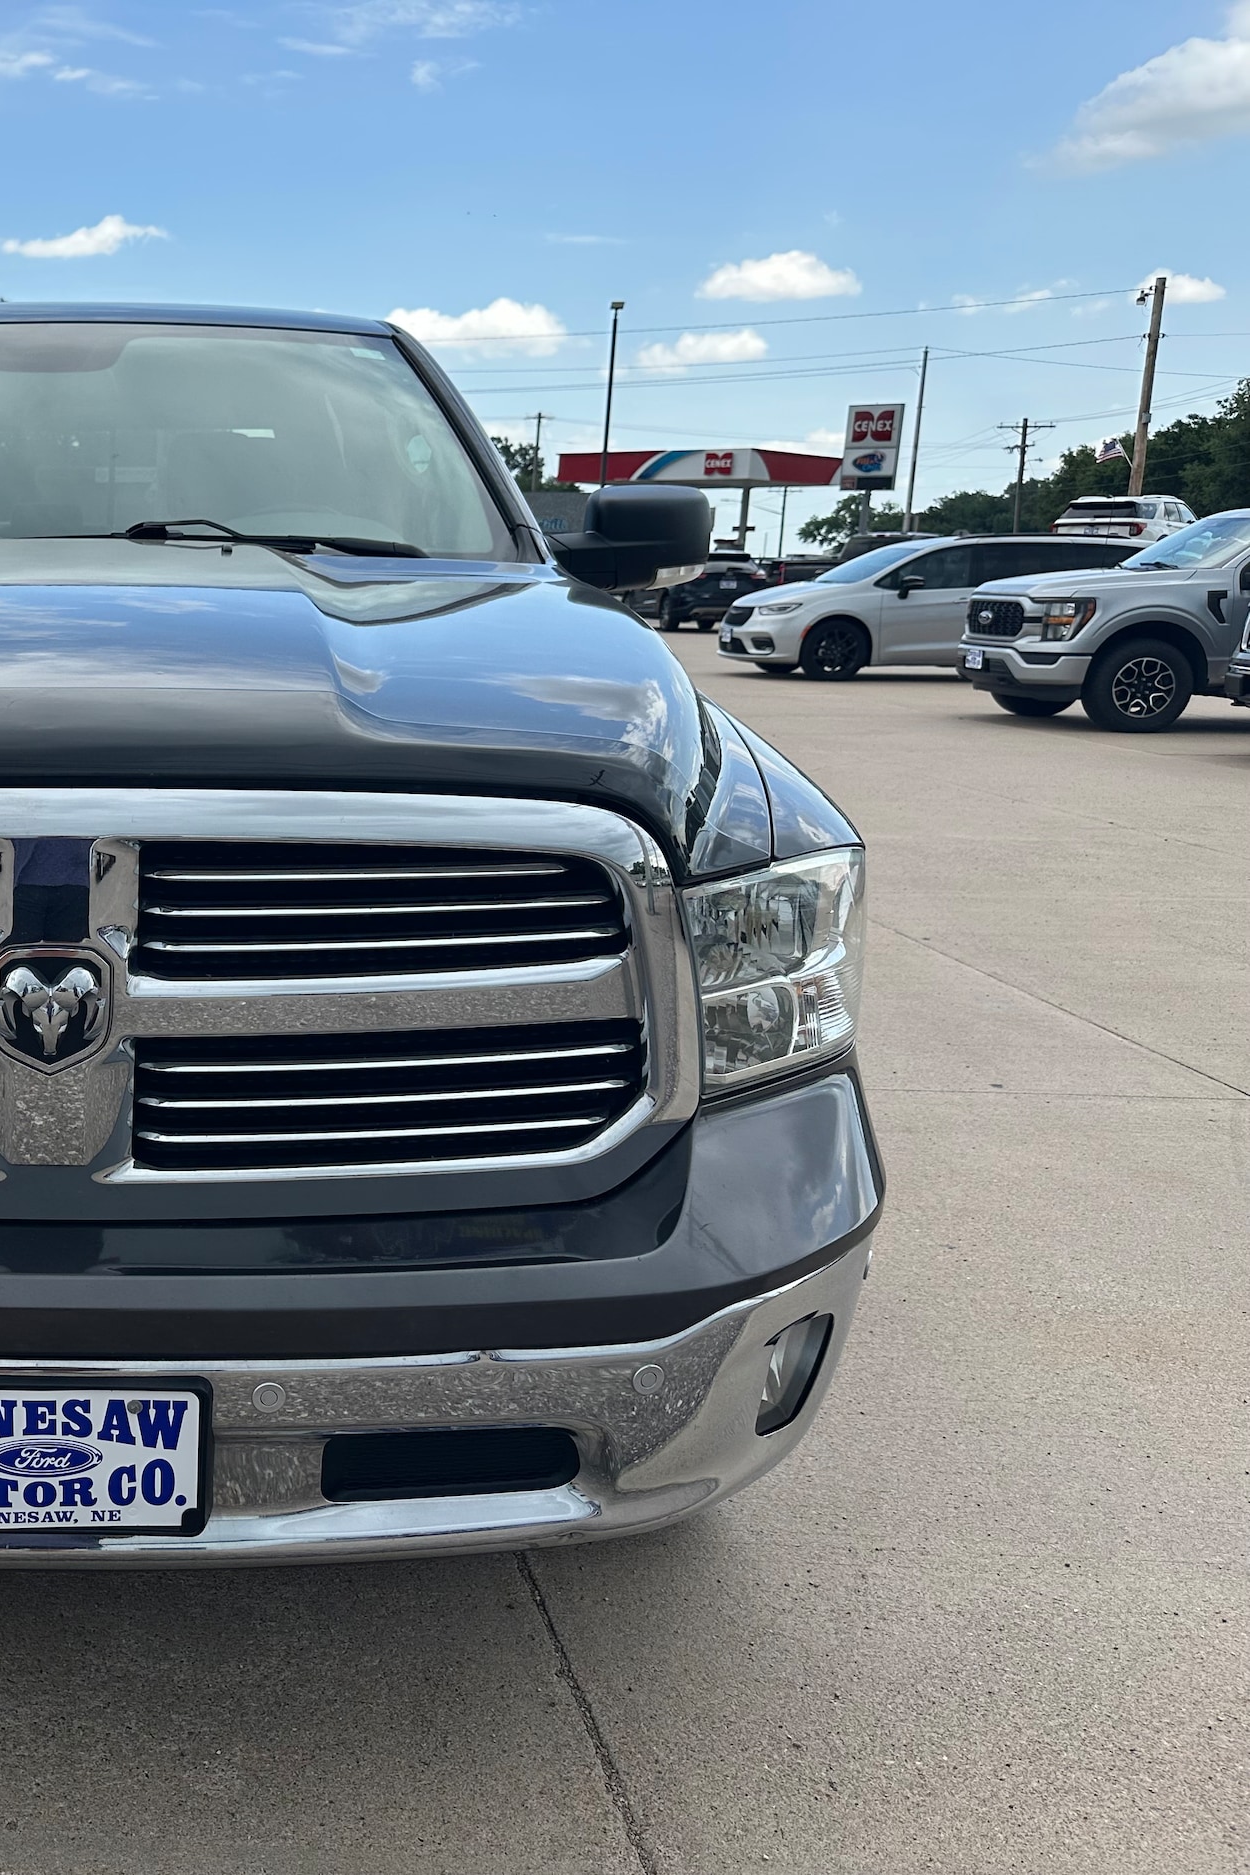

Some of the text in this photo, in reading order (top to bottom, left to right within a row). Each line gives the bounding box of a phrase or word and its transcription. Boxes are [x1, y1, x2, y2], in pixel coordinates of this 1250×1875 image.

[854, 419, 893, 432] CENEX
[705, 458, 732, 469] CENEX
[14, 1446, 72, 1469] Ford
[107, 1458, 188, 1507] CO.
[90, 1509, 122, 1522] NE
